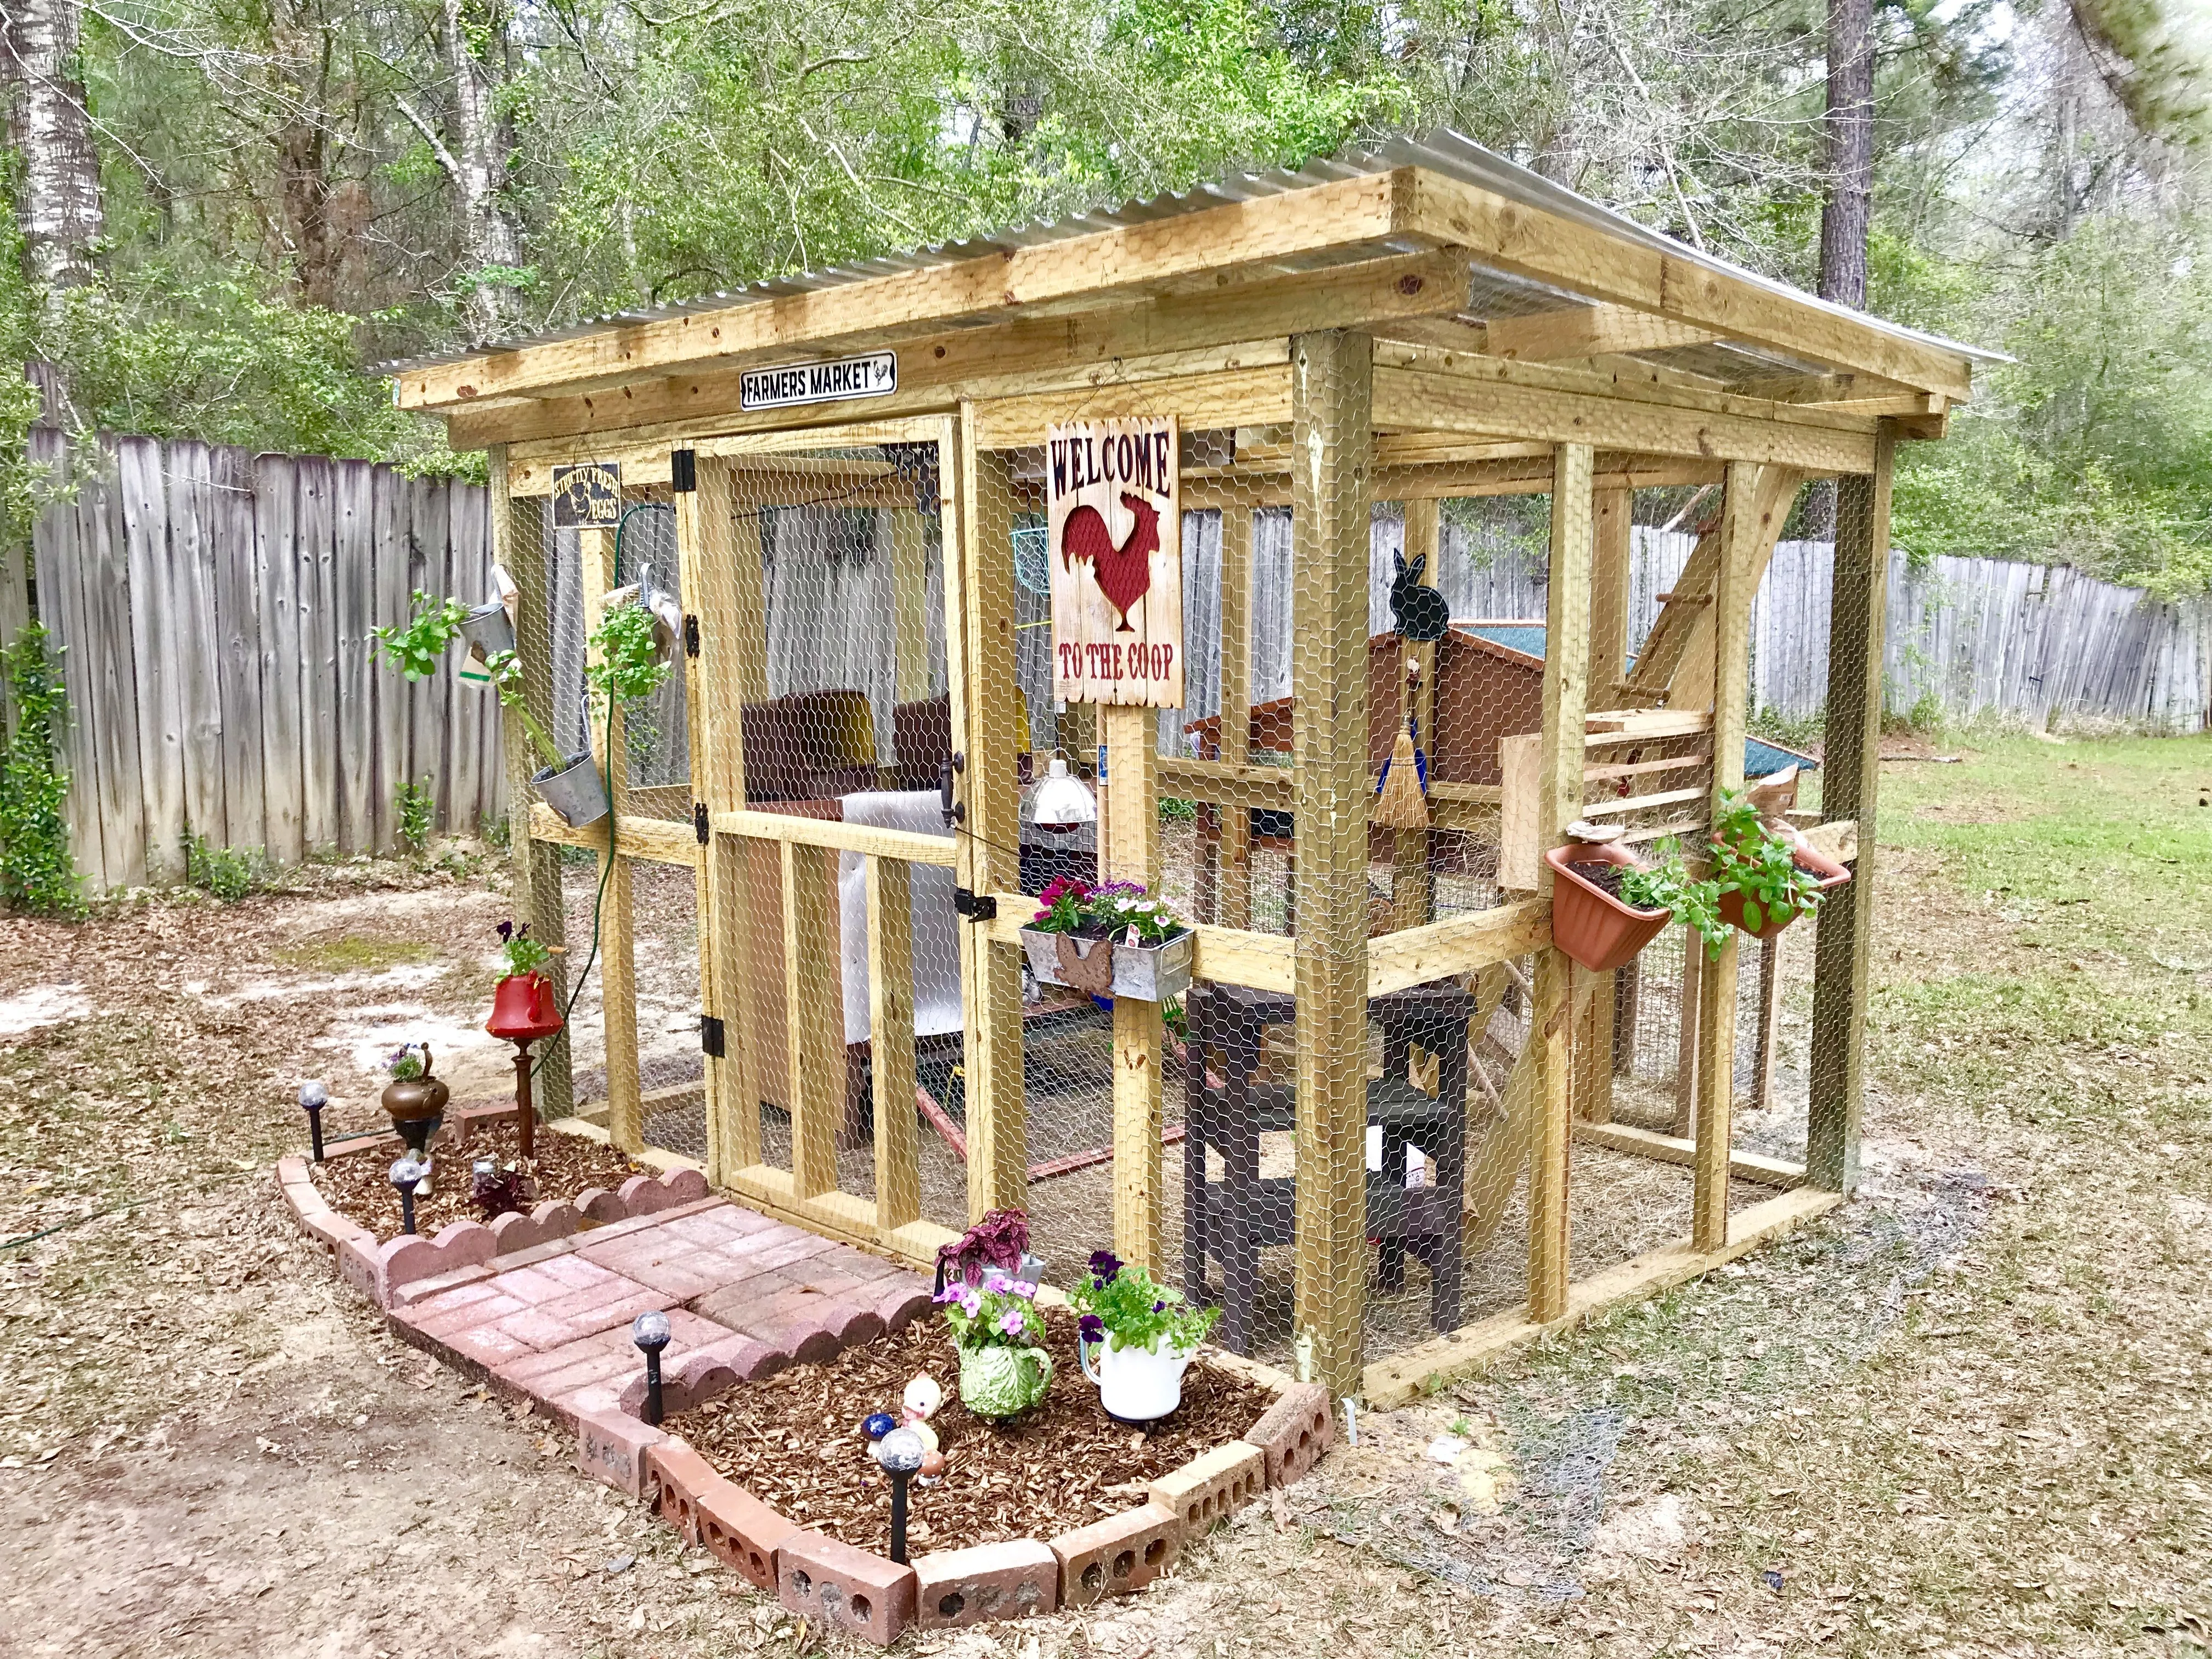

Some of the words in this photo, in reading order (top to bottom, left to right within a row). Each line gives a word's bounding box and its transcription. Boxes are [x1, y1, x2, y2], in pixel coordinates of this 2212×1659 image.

[747, 369, 805, 402] FARMERS
[810, 361, 871, 395] MARKET
[555, 467, 590, 500] STRICTLY
[591, 467, 619, 498] FRESH
[1050, 432, 1171, 501] WELCOME
[591, 498, 617, 520] EGGS
[1059, 642, 1082, 680] TO
[1086, 642, 1124, 680] THE
[1127, 642, 1174, 681] COOP
